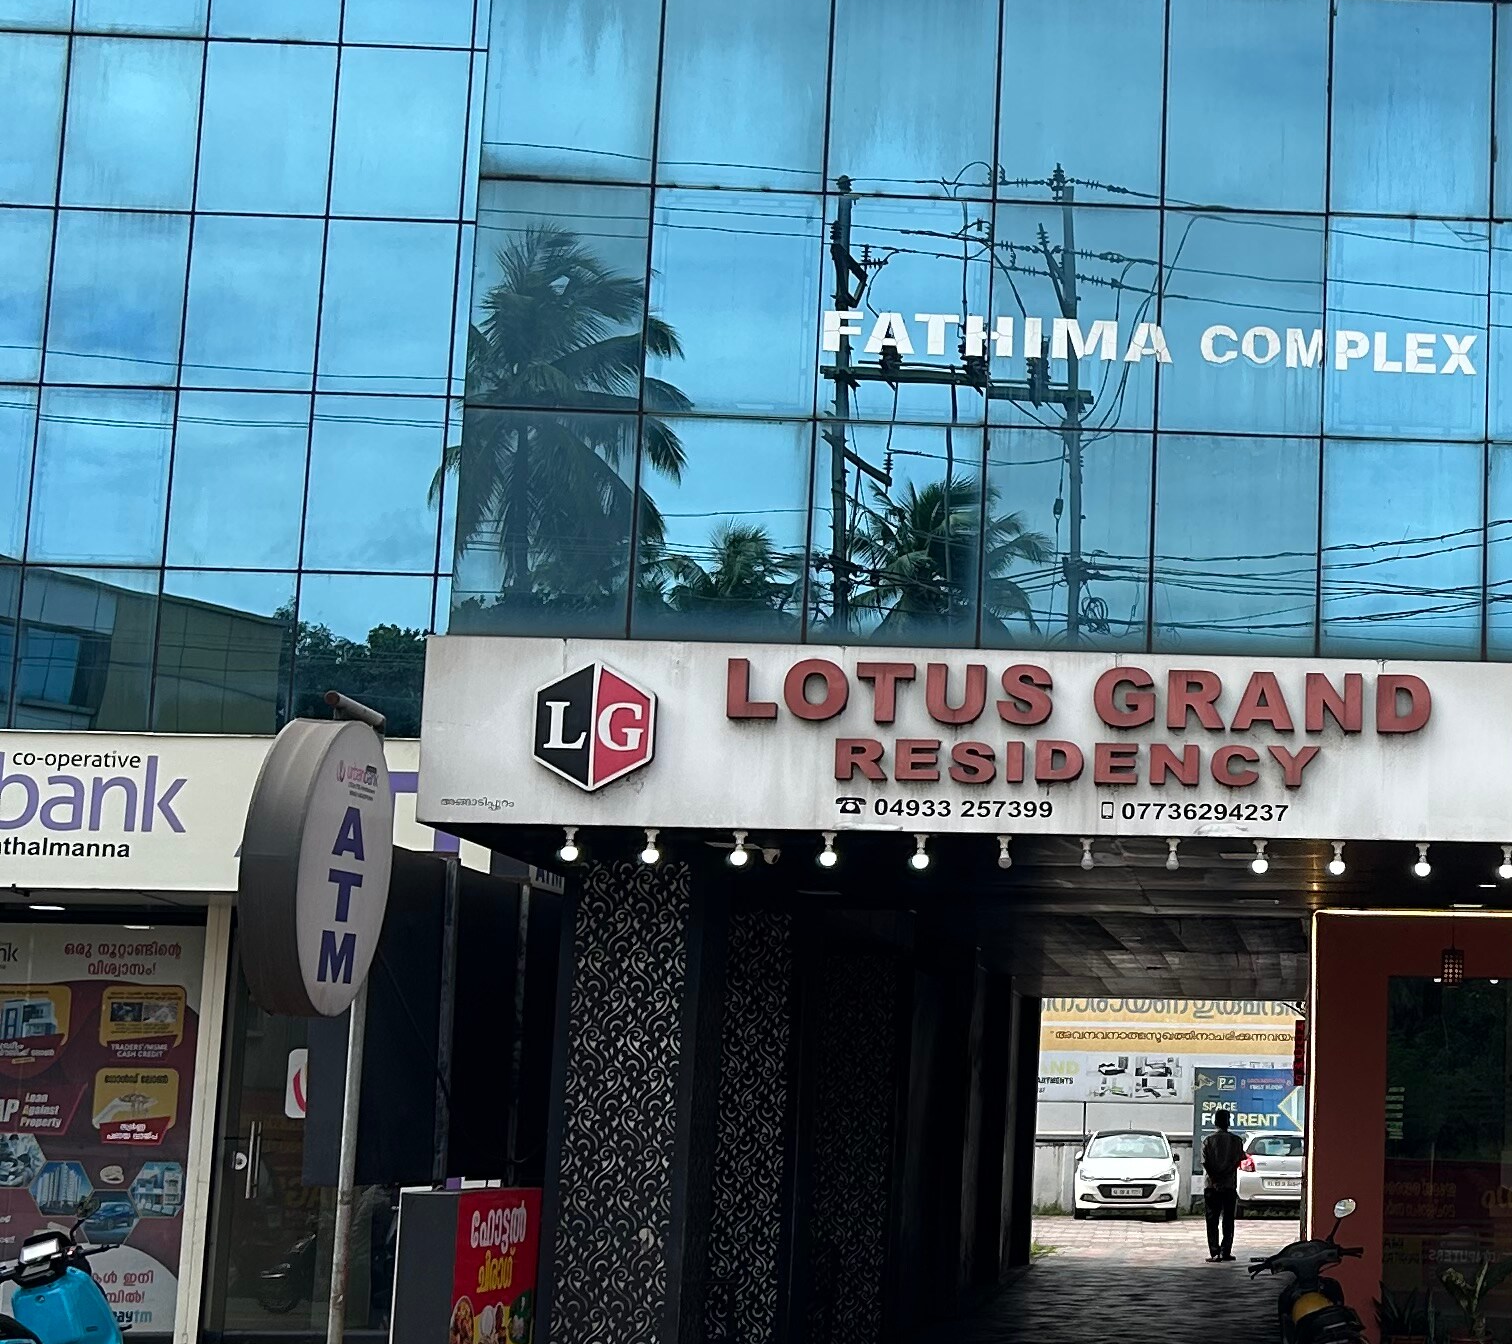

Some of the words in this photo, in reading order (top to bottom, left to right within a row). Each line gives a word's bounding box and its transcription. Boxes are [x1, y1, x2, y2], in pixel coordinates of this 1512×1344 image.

[821, 310, 1173, 364] FATHIMA
[1200, 324, 1477, 375] COMPLEX
[725, 657, 1053, 726] LOTUS
[1093, 666, 1433, 735] GRAND
[543, 700, 644, 753] LG
[13, 751, 141, 771] co-operative
[834, 737, 1321, 788] RESIDENCY
[873, 798, 952, 818] 04933
[960, 799, 1053, 820] 257399
[1121, 801, 1290, 823] 07736294237
[0, 836, 131, 858] thalmanna
[1202, 1101, 1238, 1112] SPACE
[1237, 1113, 1281, 1127] RENT
[114, 1309, 153, 1324] aytm
